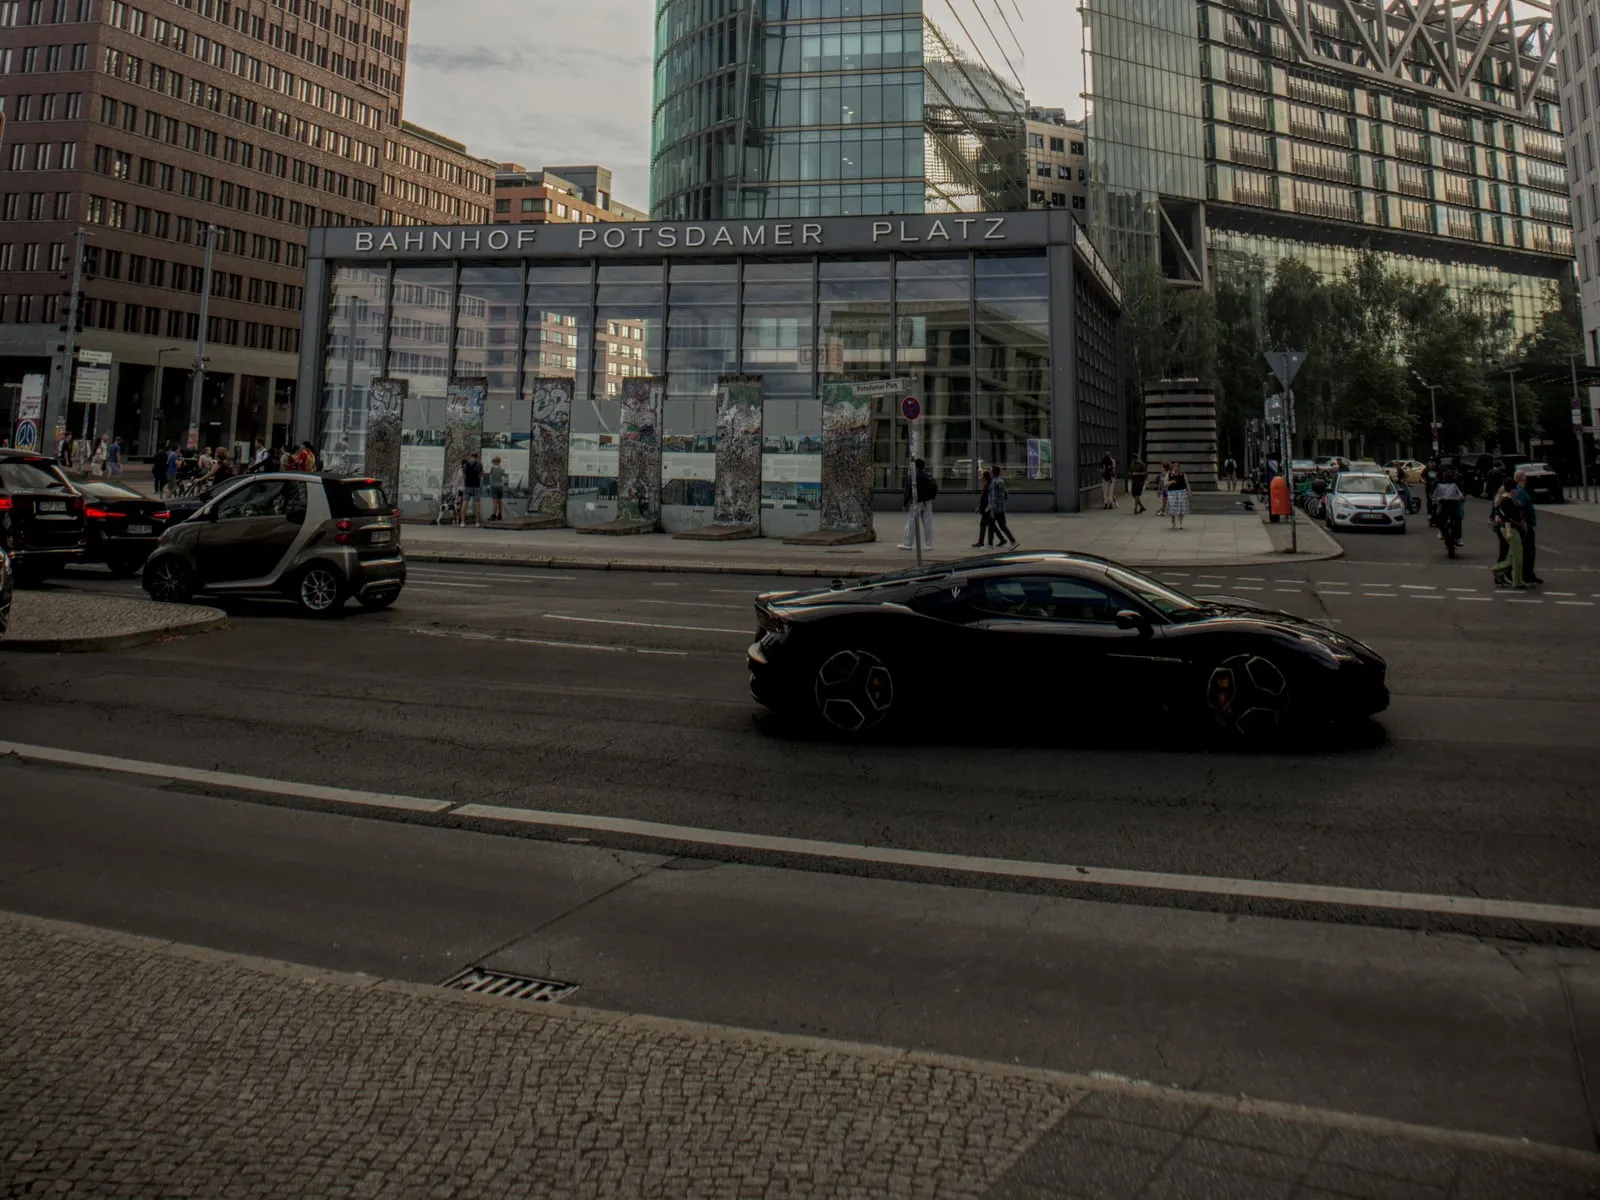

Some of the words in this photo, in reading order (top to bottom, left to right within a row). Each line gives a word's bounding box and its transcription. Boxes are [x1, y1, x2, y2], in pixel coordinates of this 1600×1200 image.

[355, 229, 536, 251] BAHNHOF
[577, 223, 822, 248] POTSDAMER
[872, 218, 1006, 242] PLATZ
[856, 383, 885, 392] Potsdamer
